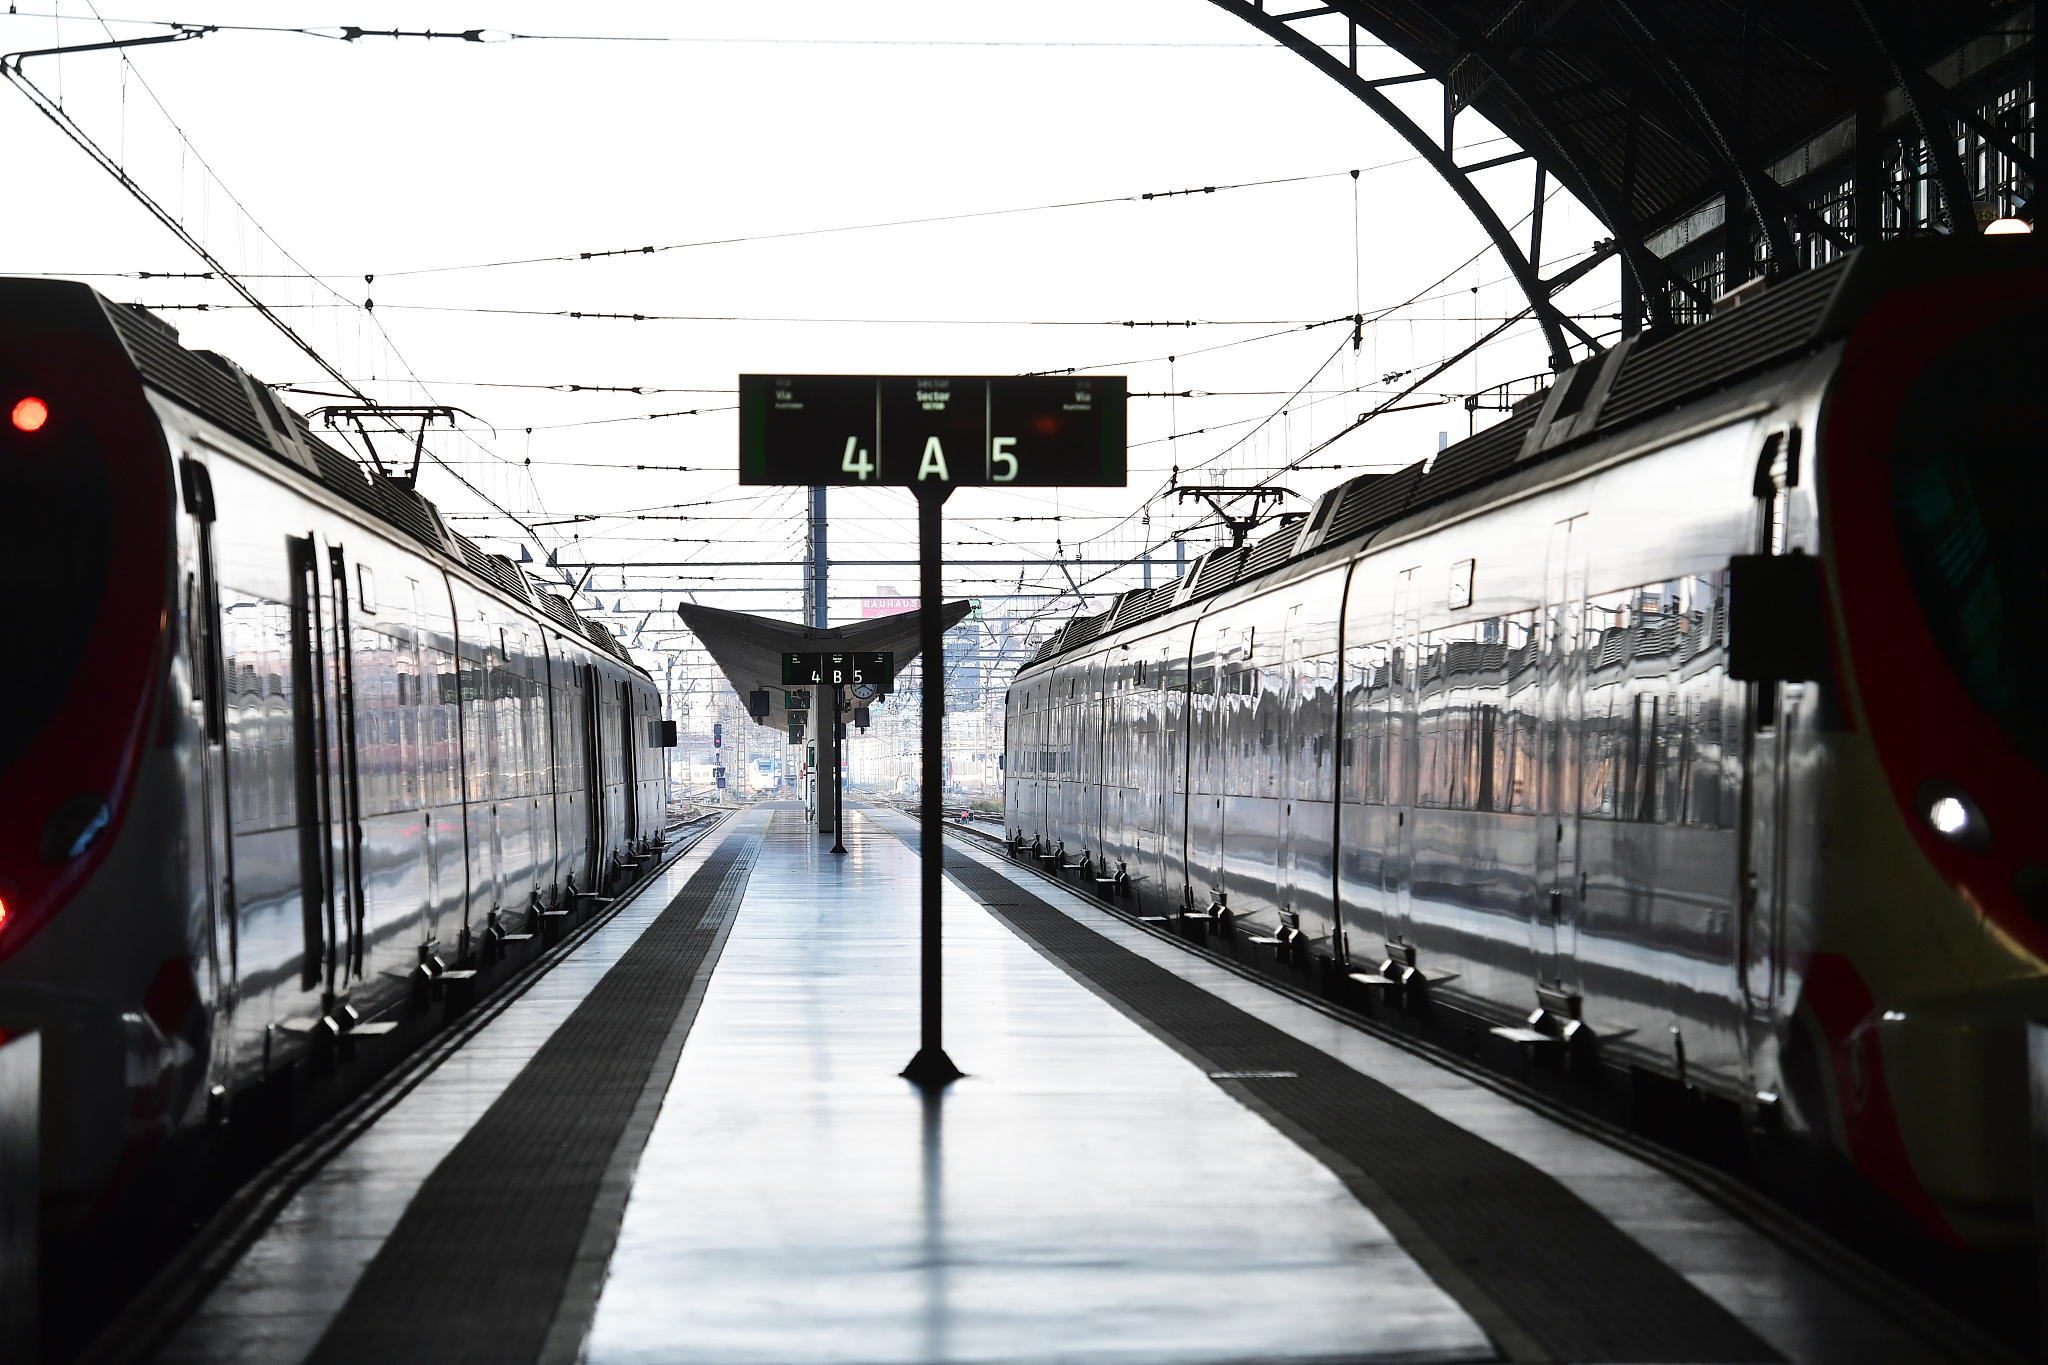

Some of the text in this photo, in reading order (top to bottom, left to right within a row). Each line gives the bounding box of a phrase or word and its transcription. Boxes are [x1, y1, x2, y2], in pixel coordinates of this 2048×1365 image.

[916, 390, 950, 401] Sector
[841, 436, 1018, 481] 4 A 5
[864, 599, 918, 608] BAUHAUS
[811, 670, 863, 684] 4 B 5
